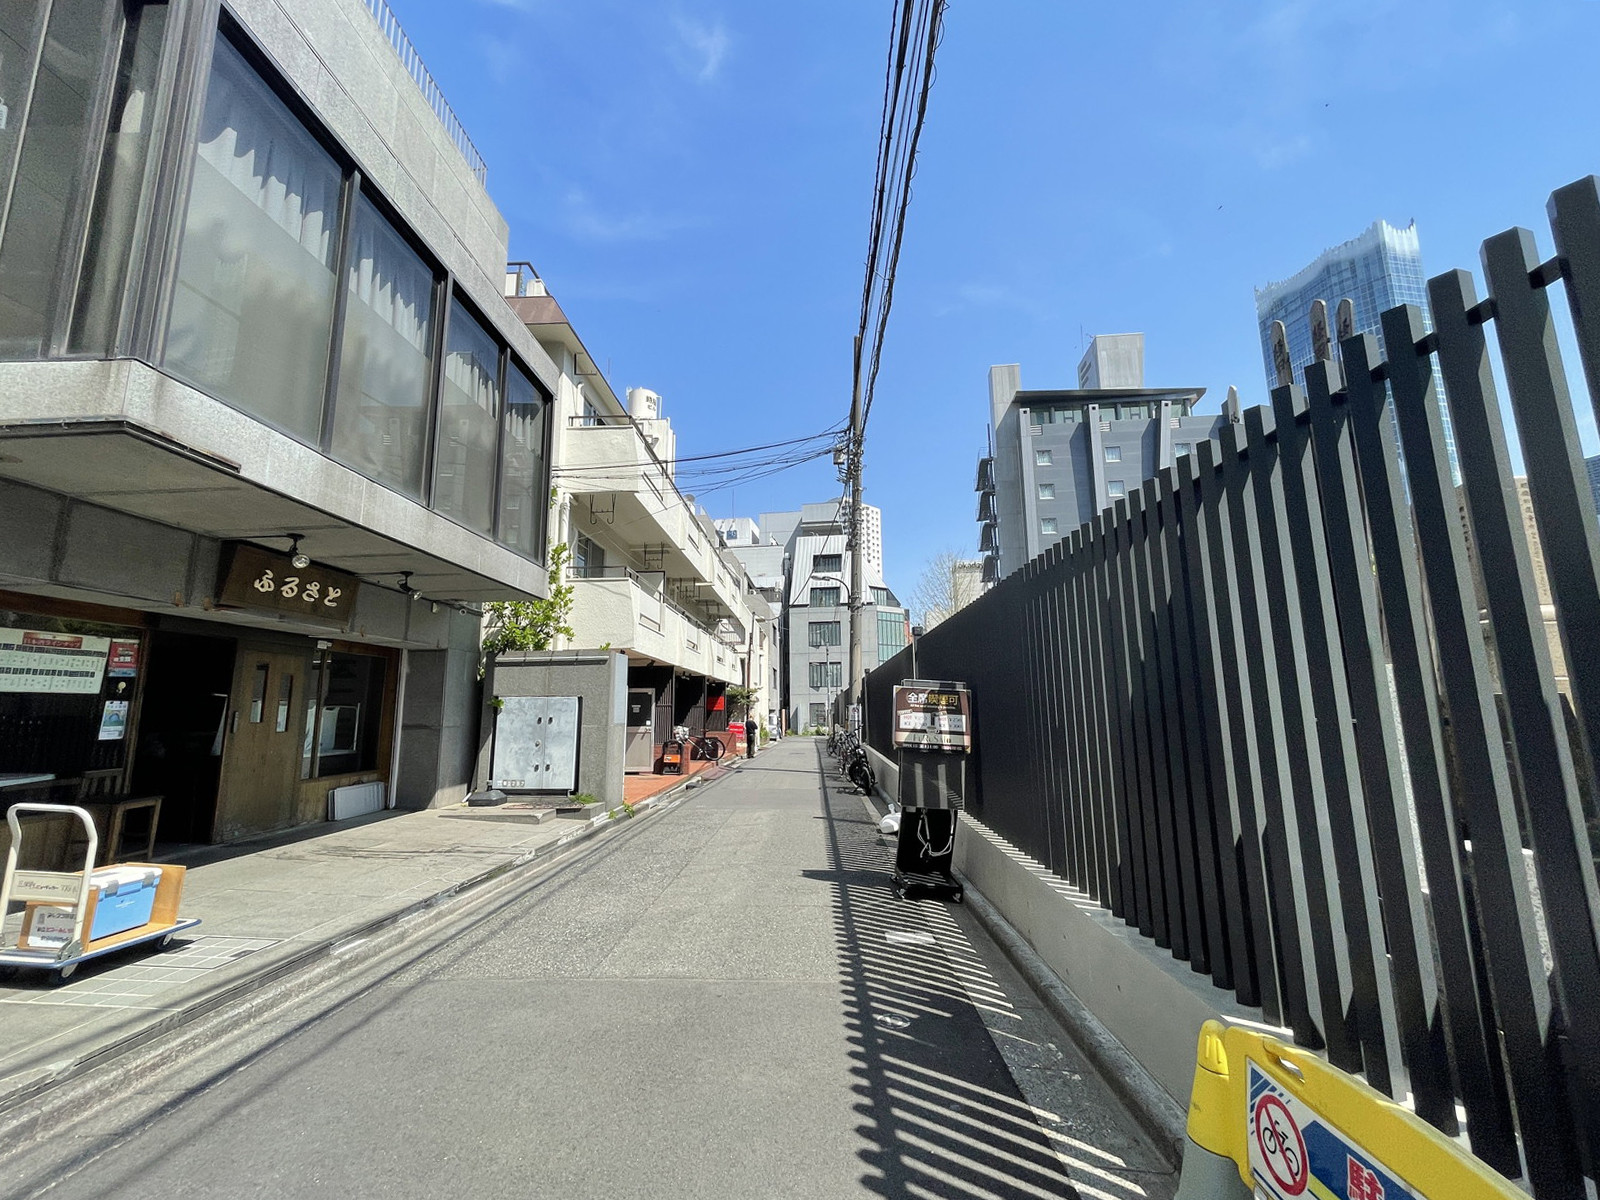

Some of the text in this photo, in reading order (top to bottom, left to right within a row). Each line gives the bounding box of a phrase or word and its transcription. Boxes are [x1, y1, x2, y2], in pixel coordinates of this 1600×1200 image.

[254, 570, 341, 607] ふるさと
[907, 692, 958, 705] 全席喫煙可
